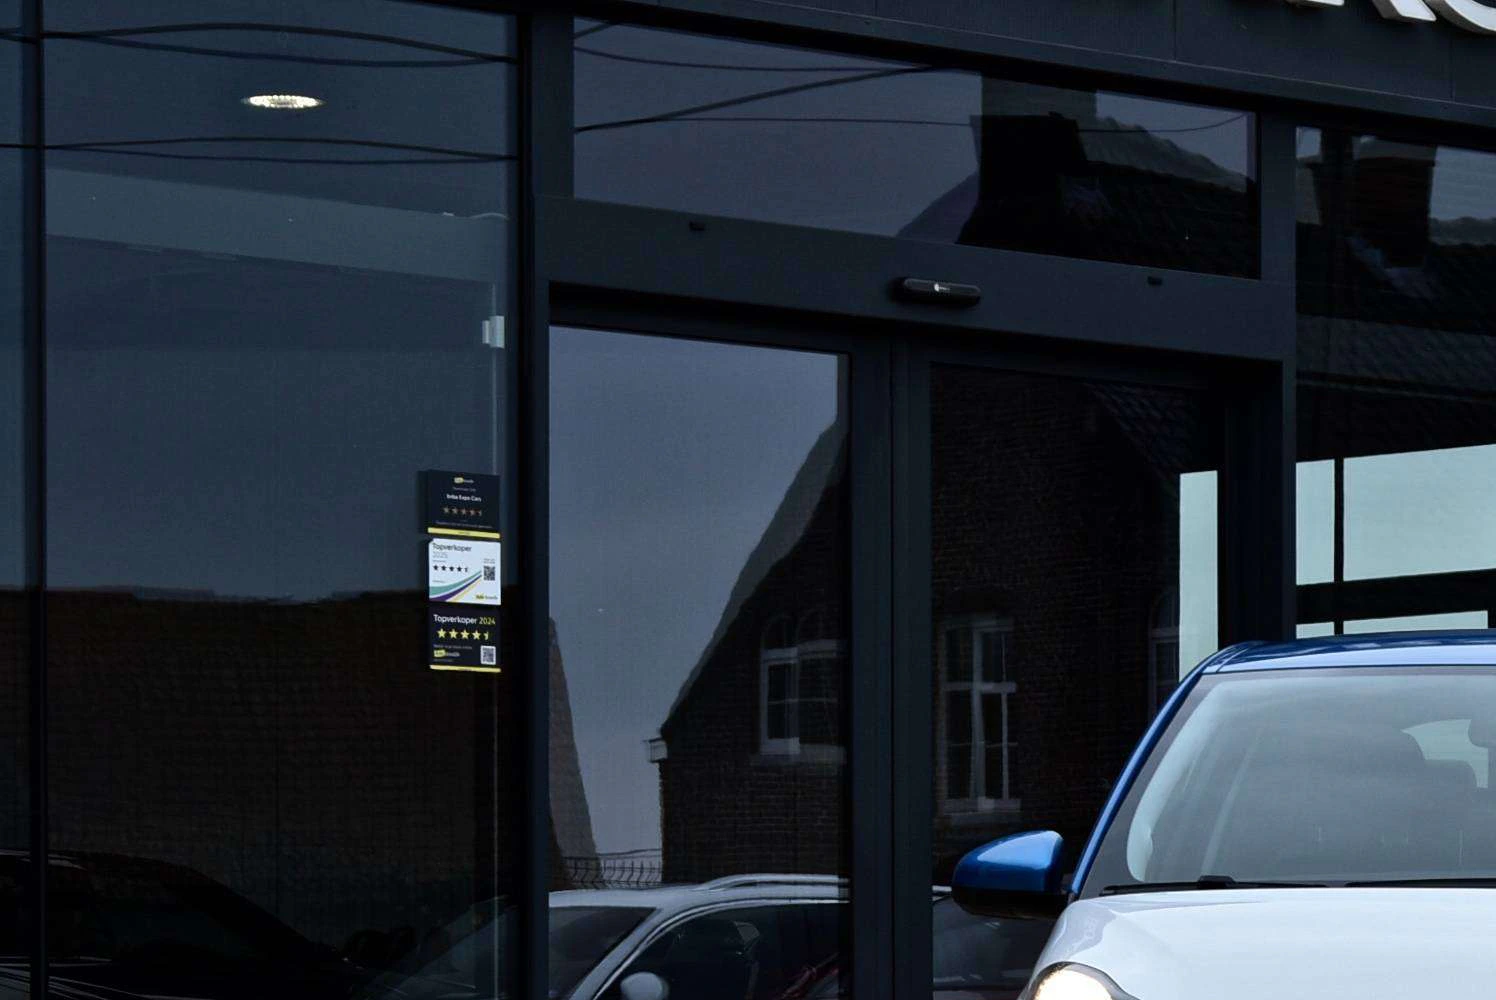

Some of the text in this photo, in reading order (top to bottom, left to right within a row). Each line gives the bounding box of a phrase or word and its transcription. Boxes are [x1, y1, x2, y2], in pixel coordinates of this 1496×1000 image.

[432, 543, 472, 553] Topverkoper
[433, 614, 496, 626] Topverkoper 2024
